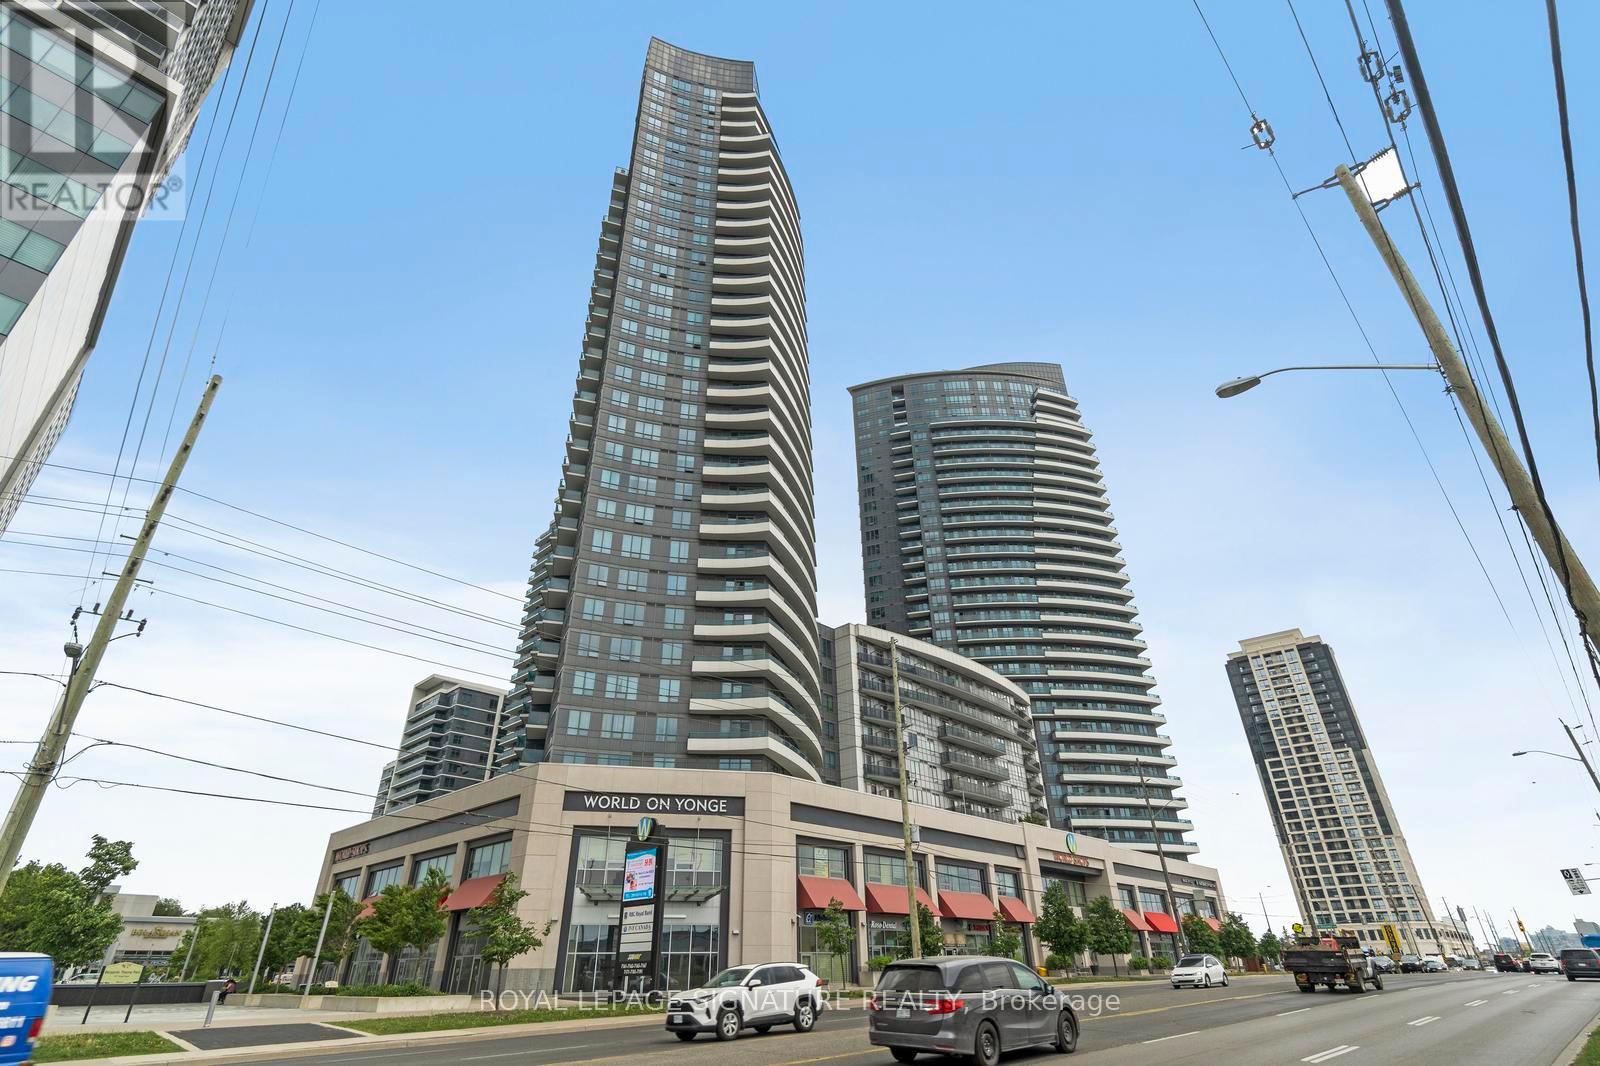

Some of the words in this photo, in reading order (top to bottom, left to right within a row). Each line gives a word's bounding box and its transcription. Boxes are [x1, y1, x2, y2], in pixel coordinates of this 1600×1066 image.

[584, 795, 640, 809] WORLD
[646, 797, 671, 811] ON
[675, 798, 727, 812] YONGE
